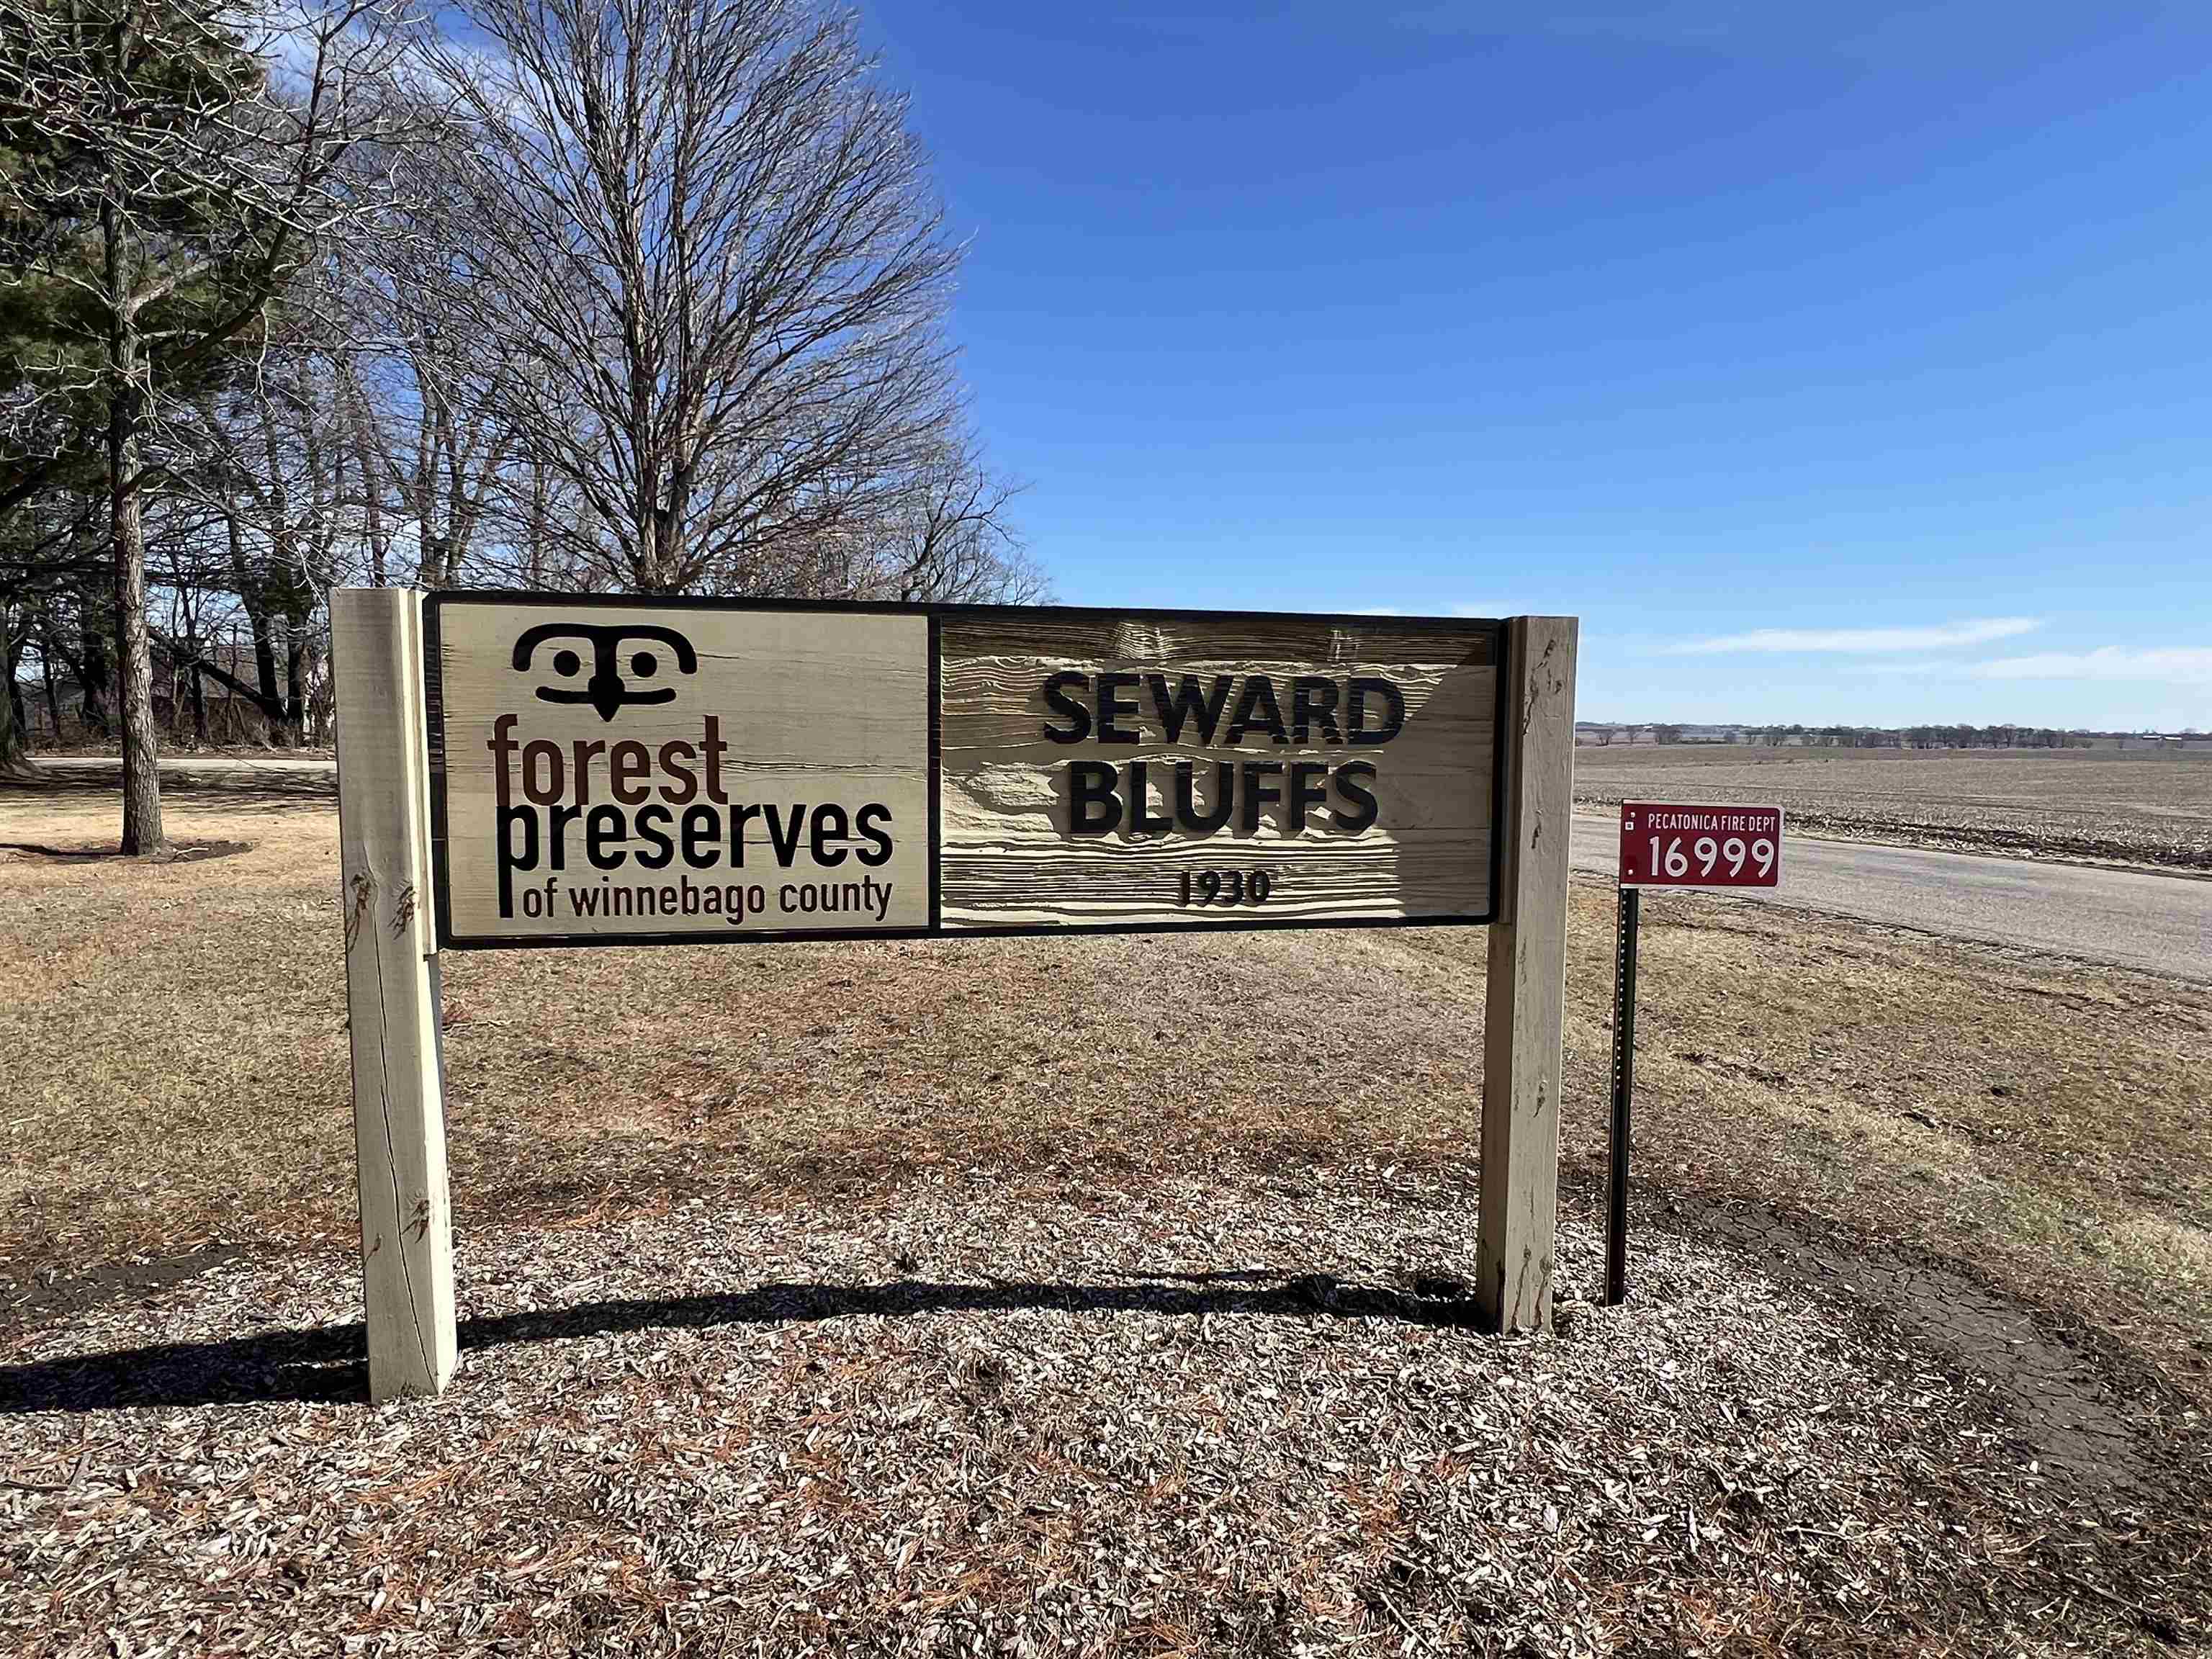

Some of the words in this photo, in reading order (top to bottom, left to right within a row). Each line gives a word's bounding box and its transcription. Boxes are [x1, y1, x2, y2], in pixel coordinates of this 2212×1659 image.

[1043, 671, 1406, 745] SEWARD
[487, 714, 729, 806] forest
[1067, 760, 1380, 835] BLUFFS
[1647, 813, 1718, 830] PECATONICA
[1722, 815, 1745, 831] FIRE
[1749, 817, 1776, 832] DEPT
[497, 802, 894, 918] preserves
[1179, 869, 1272, 907] 1930
[1649, 836, 1774, 878] 16999
[523, 877, 558, 917] of
[569, 875, 765, 925] winnebago
[779, 875, 893, 922] county
